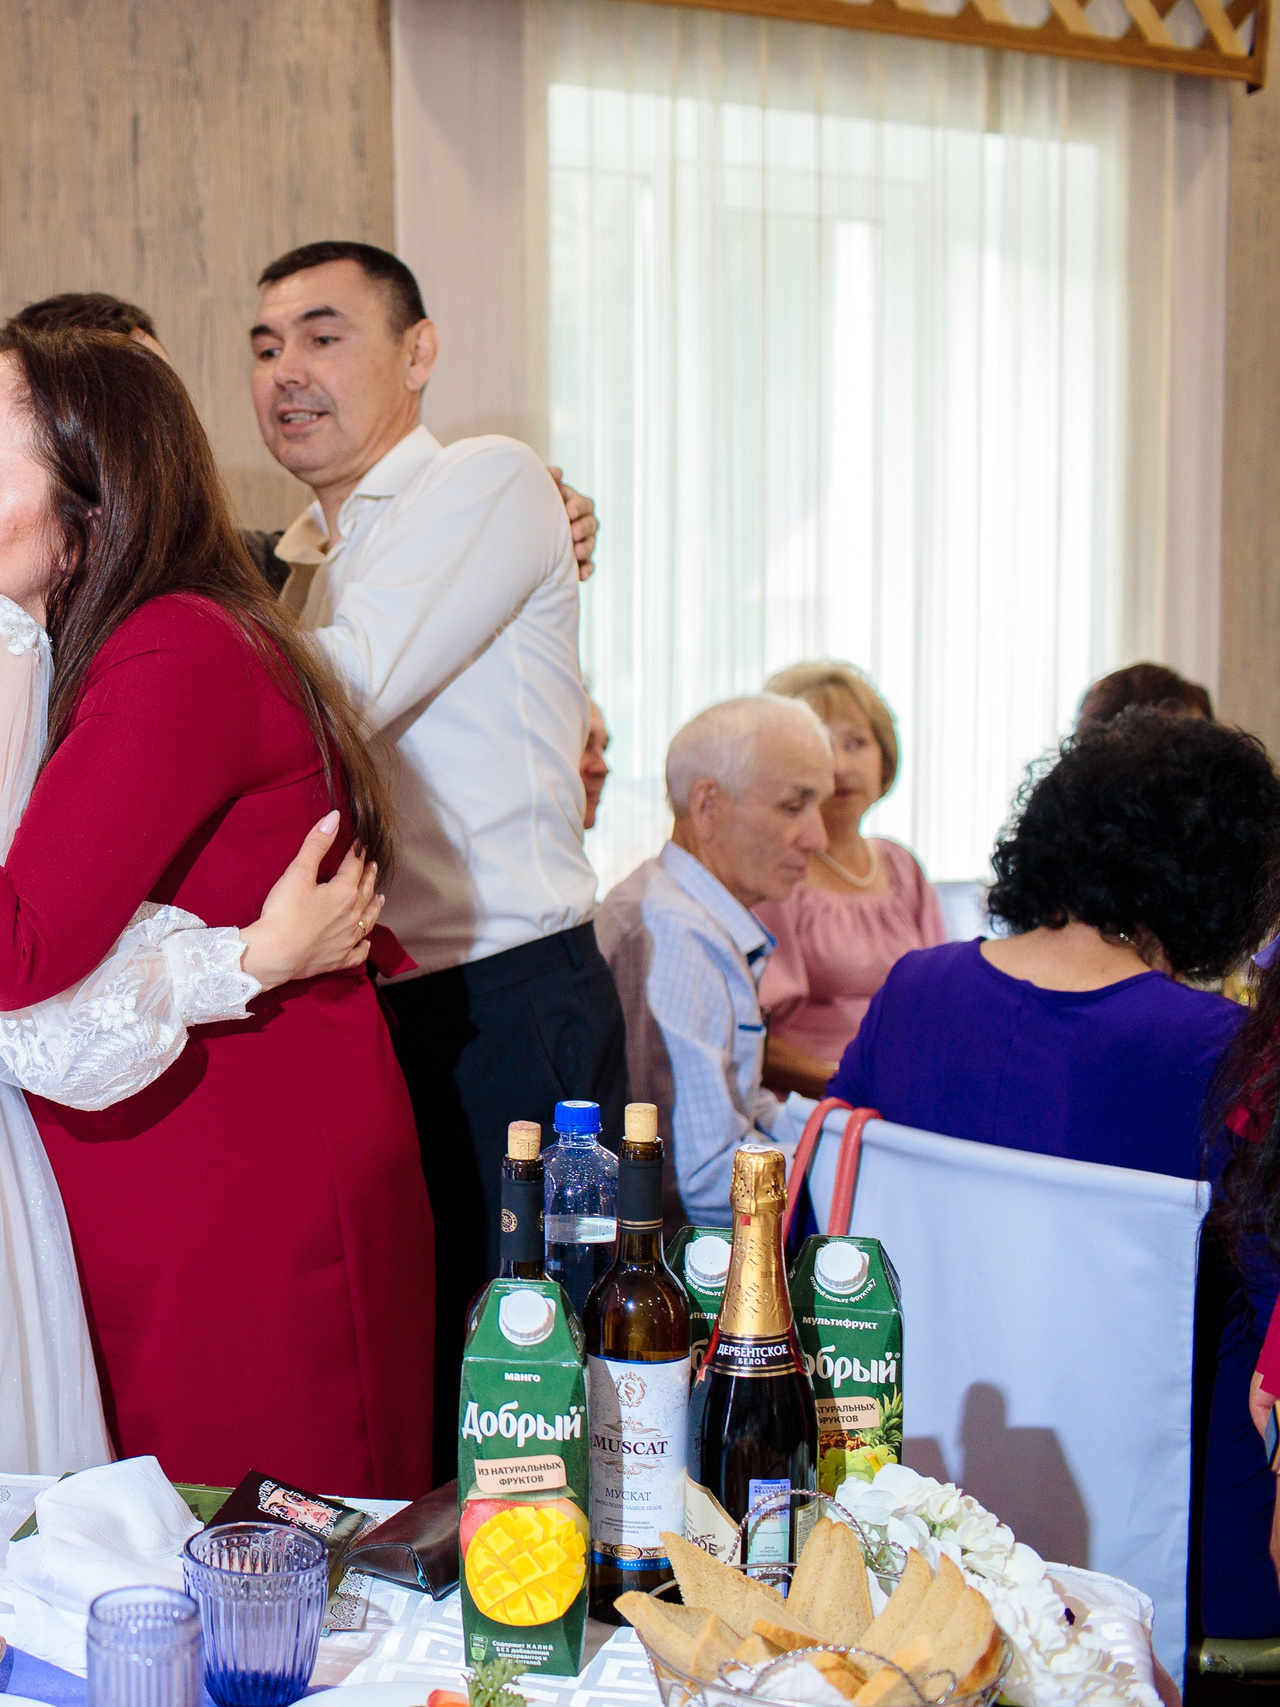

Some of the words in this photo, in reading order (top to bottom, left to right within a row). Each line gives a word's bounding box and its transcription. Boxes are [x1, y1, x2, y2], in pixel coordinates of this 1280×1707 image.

[802, 1316, 878, 1330] мультифрукт
[717, 1343, 788, 1358] ДЕРБЕНТСКОЕ
[803, 1344, 897, 1389] обрый
[504, 1372, 541, 1383] манго
[817, 1403, 876, 1415] ТУРАЛЬНЫХ
[461, 1400, 582, 1448] Добрый
[593, 1434, 668, 1455] MUSCAT
[478, 1467, 490, 1476] ИЗ
[491, 1461, 562, 1476] НАТУРАЛЬНЫХ
[499, 1475, 545, 1486] ФРУКТОВ
[605, 1487, 652, 1501] МУСКАТ
